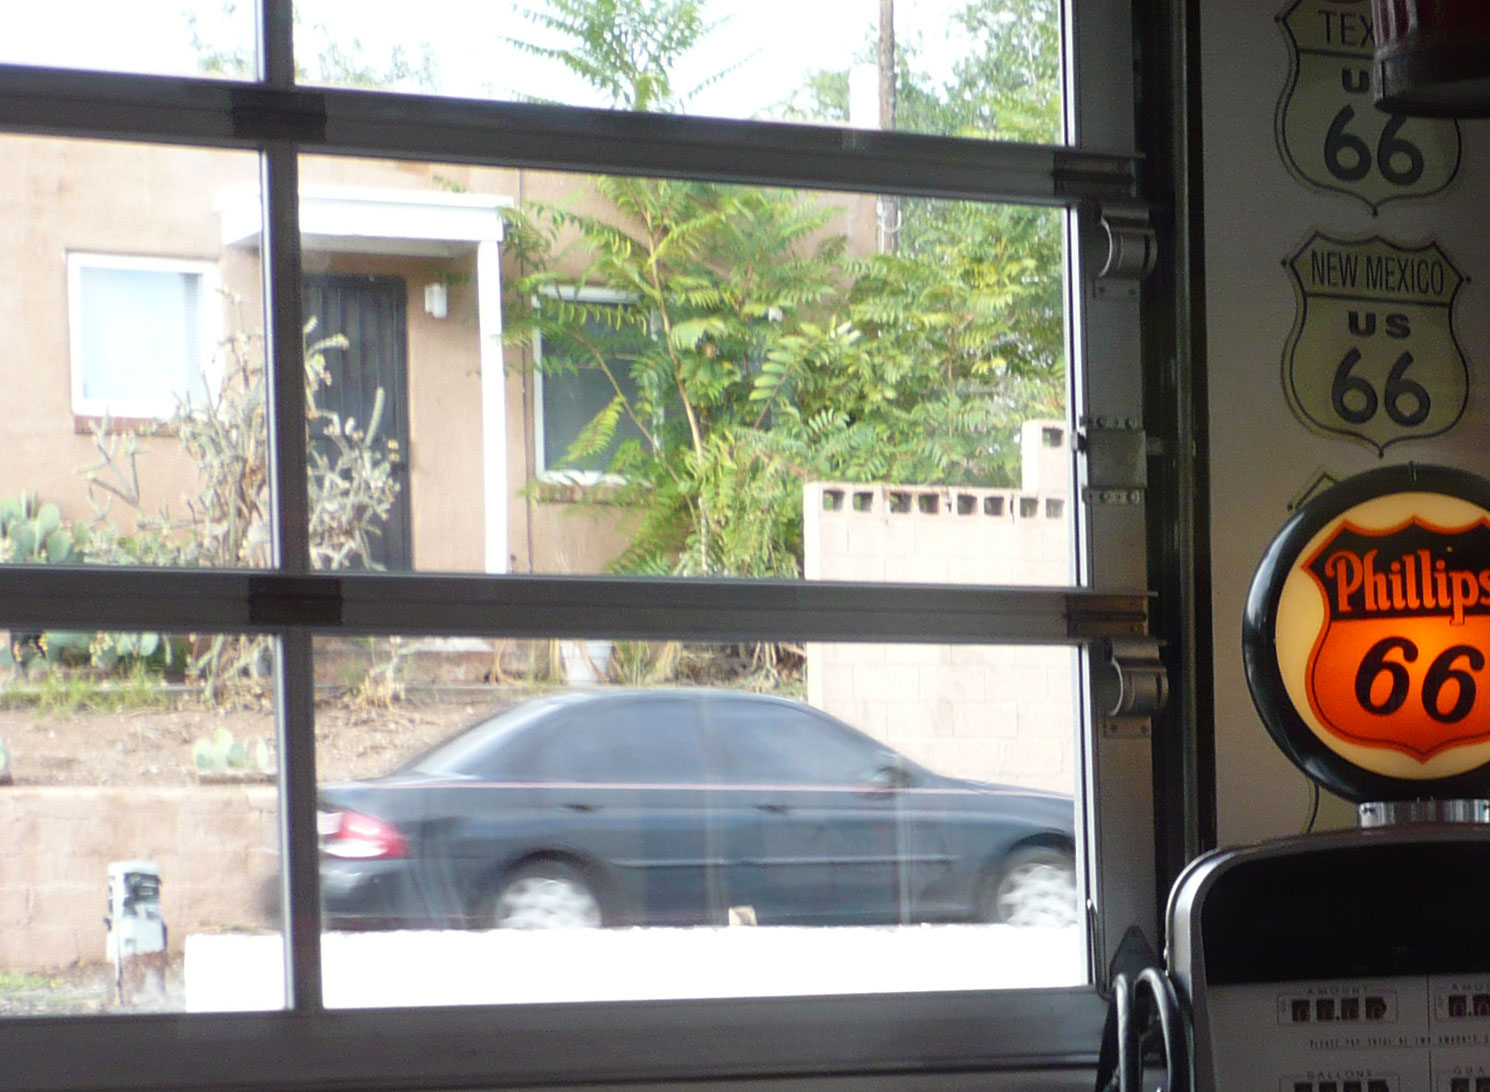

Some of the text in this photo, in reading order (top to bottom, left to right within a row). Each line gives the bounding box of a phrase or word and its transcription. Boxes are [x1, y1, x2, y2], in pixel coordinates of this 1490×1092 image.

[1323, 104, 1425, 186] 66
[1311, 249, 1445, 296] NEW MEXICO
[1348, 310, 1411, 339] US
[1331, 346, 1431, 428] 66
[1355, 636, 1485, 724] 66
